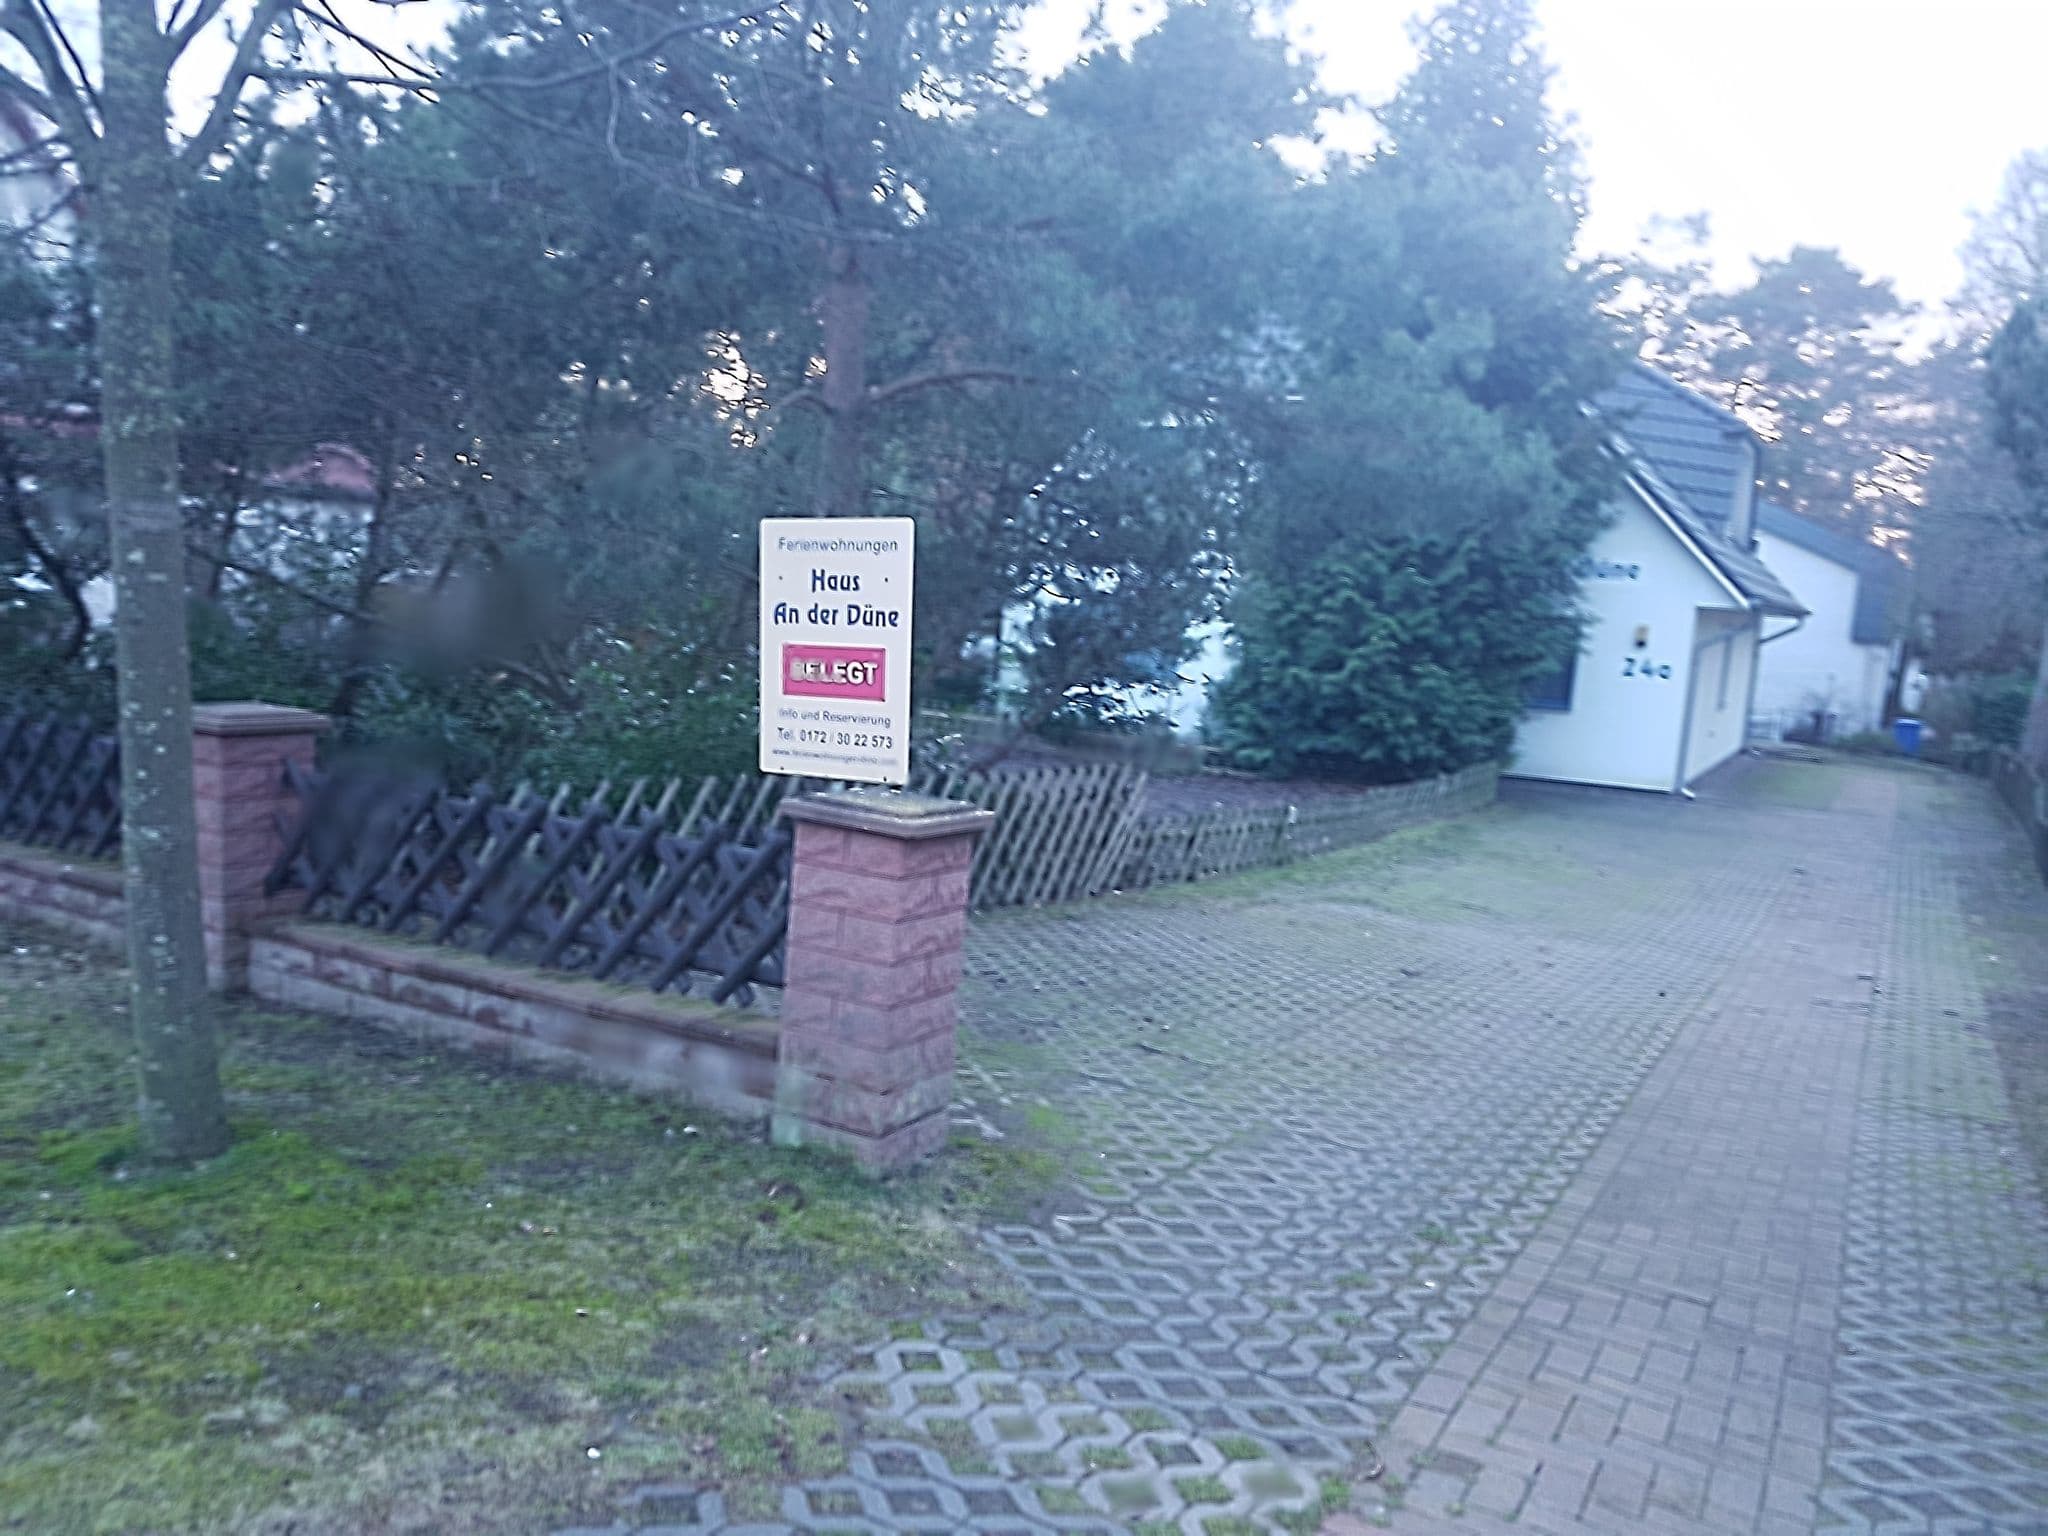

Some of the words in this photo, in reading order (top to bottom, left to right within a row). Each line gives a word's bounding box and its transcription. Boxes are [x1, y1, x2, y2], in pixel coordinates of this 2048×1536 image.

[778, 536, 899, 556] Ferienwohnungen
[811, 568, 861, 593] Haus
[773, 602, 800, 626] An
[807, 602, 839, 626] der
[847, 603, 900, 628] Düne
[778, 706, 799, 719] Info
[800, 710, 820, 721] und
[822, 709, 892, 729] Reservierung
[799, 728, 827, 744] 0172
[836, 731, 851, 746] 30
[854, 733, 868, 748] 22
[871, 734, 893, 750] 573
